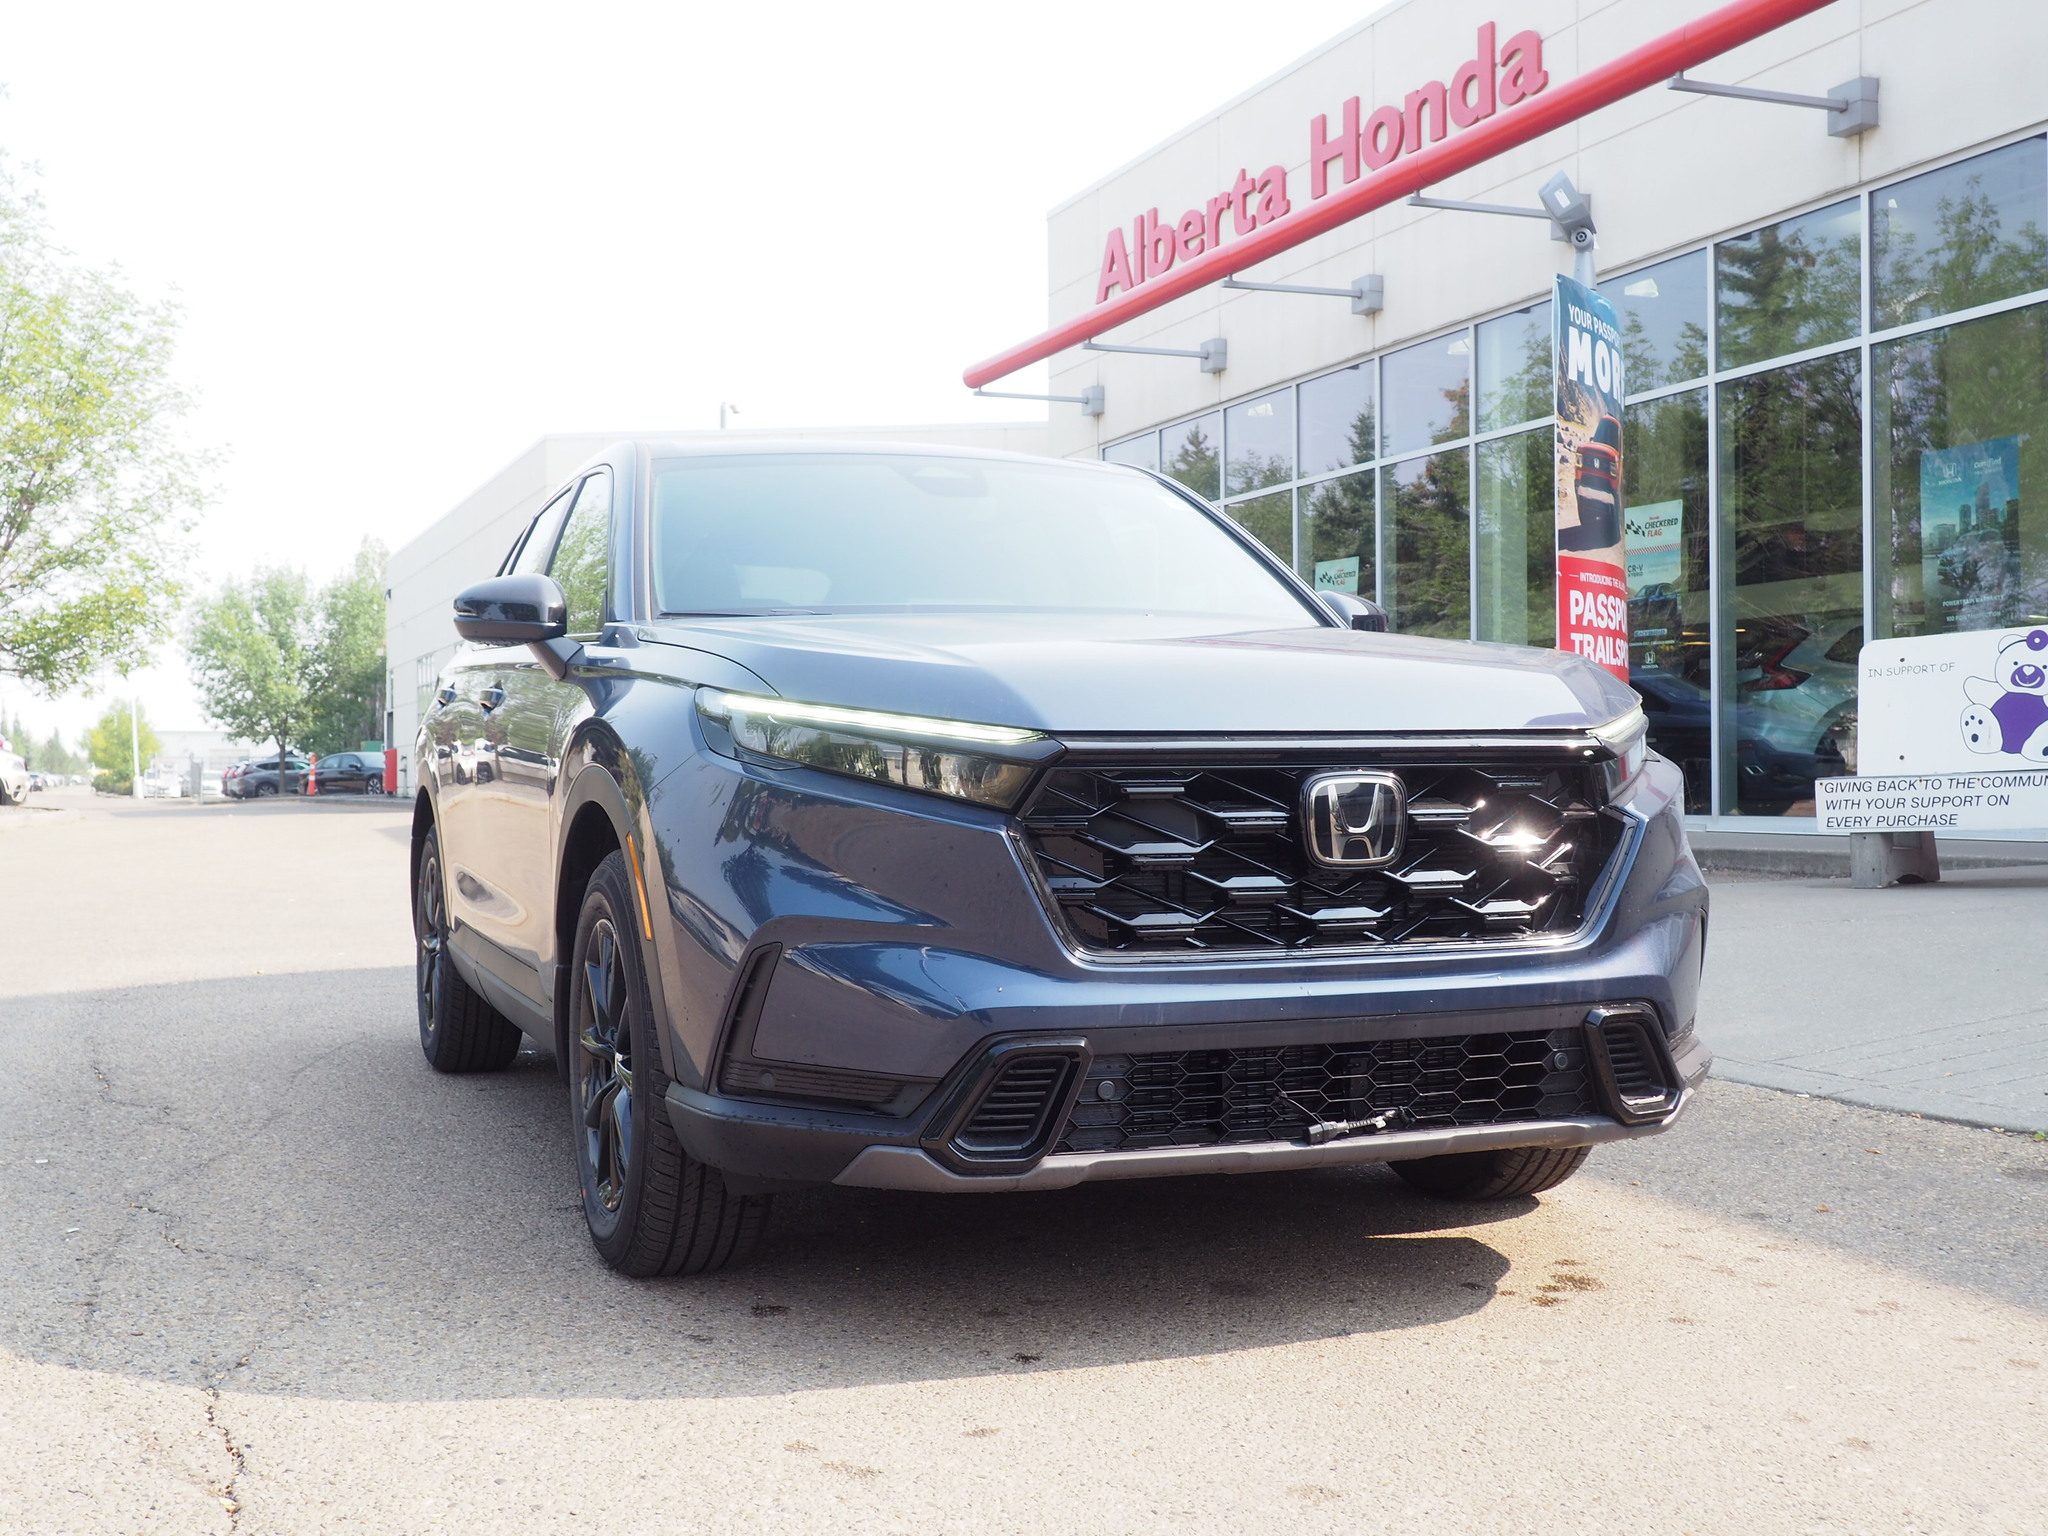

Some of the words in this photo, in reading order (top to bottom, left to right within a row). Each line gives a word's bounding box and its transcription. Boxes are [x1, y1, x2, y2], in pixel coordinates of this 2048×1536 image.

[1096, 165, 1291, 304] Alberta
[1310, 21, 1548, 200] Honda
[1568, 303, 1593, 331] YOUR
[1644, 517, 1679, 530] CHECKERED
[1647, 529, 1663, 538] FLAG
[1580, 572, 1612, 587] INTRODUCING
[1868, 669, 1883, 677] IN
[1886, 664, 1936, 677] SUPPORT
[1940, 662, 1955, 673] OF
[1824, 781, 1873, 794] GIVING
[1877, 779, 1919, 792] BACK
[1922, 778, 1943, 790] TO
[1948, 777, 1977, 789] THE
[1825, 798, 1861, 811] WITH
[1866, 797, 1906, 810] YOUR
[1910, 795, 1983, 809] SUPPORT
[1987, 794, 2010, 806] ON
[1826, 816, 1872, 828] EVERY
[1876, 814, 1959, 827] PURCHASE
